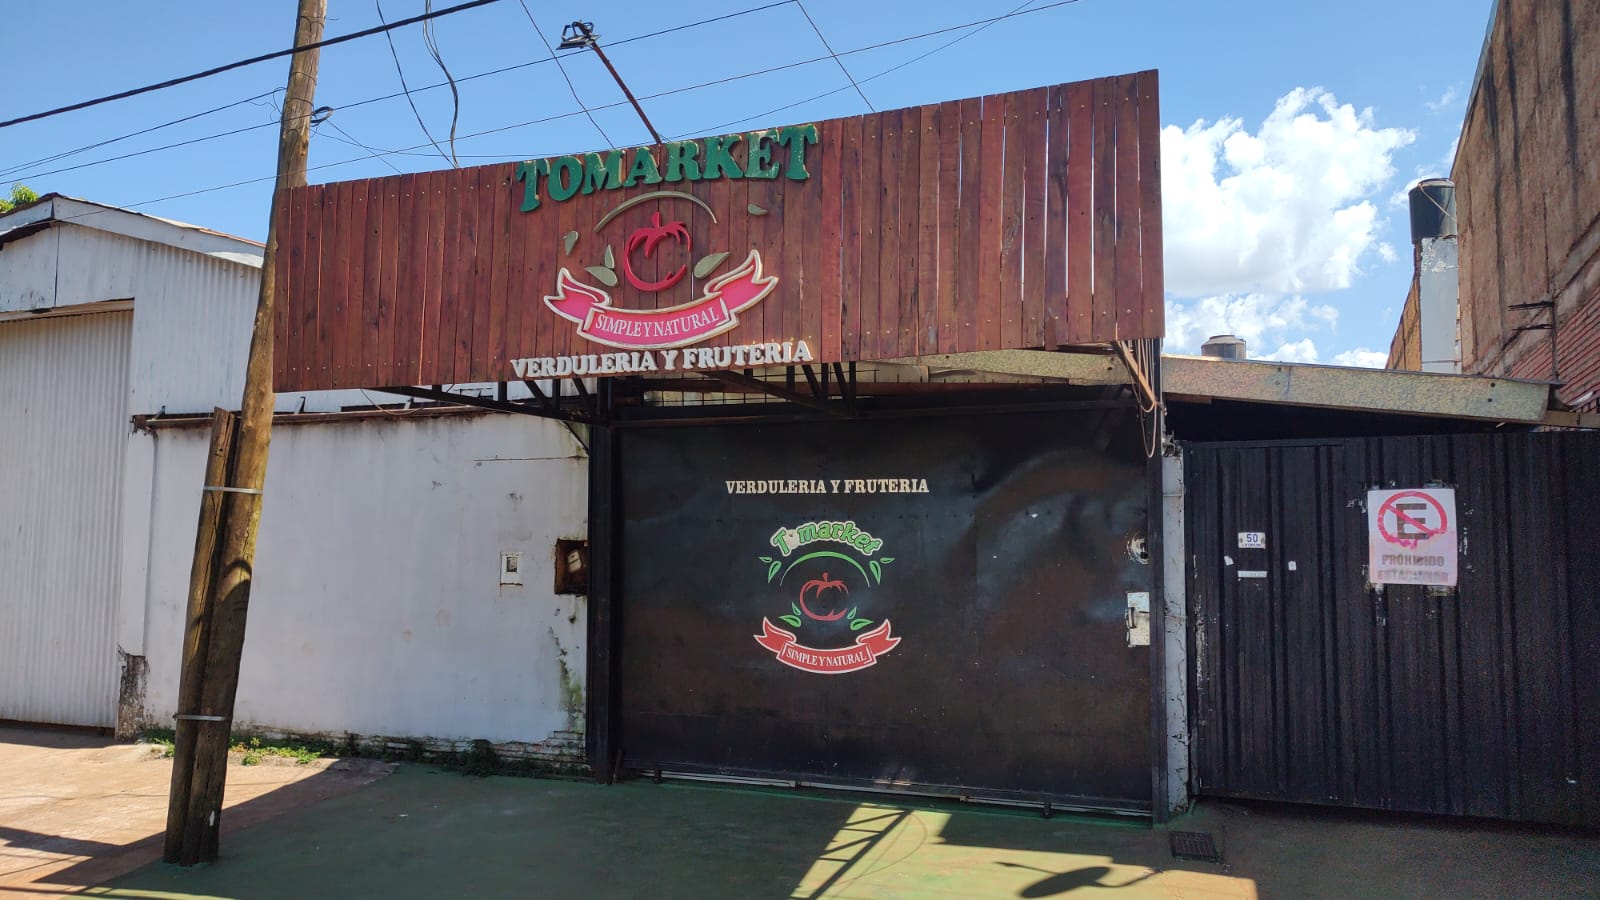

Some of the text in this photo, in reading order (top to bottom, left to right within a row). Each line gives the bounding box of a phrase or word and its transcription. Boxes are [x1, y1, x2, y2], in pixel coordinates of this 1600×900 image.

[516, 123, 818, 213] TOMARKET
[595, 307, 720, 337] SIMPLE Y NATURAL
[510, 339, 814, 378] VERDULERIA Y FRUTERIA
[725, 478, 930, 494] VERDULERIA Y FRUTERIA
[1246, 533, 1259, 543] 50
[786, 647, 867, 667] SIMPLE Y NATURAL
